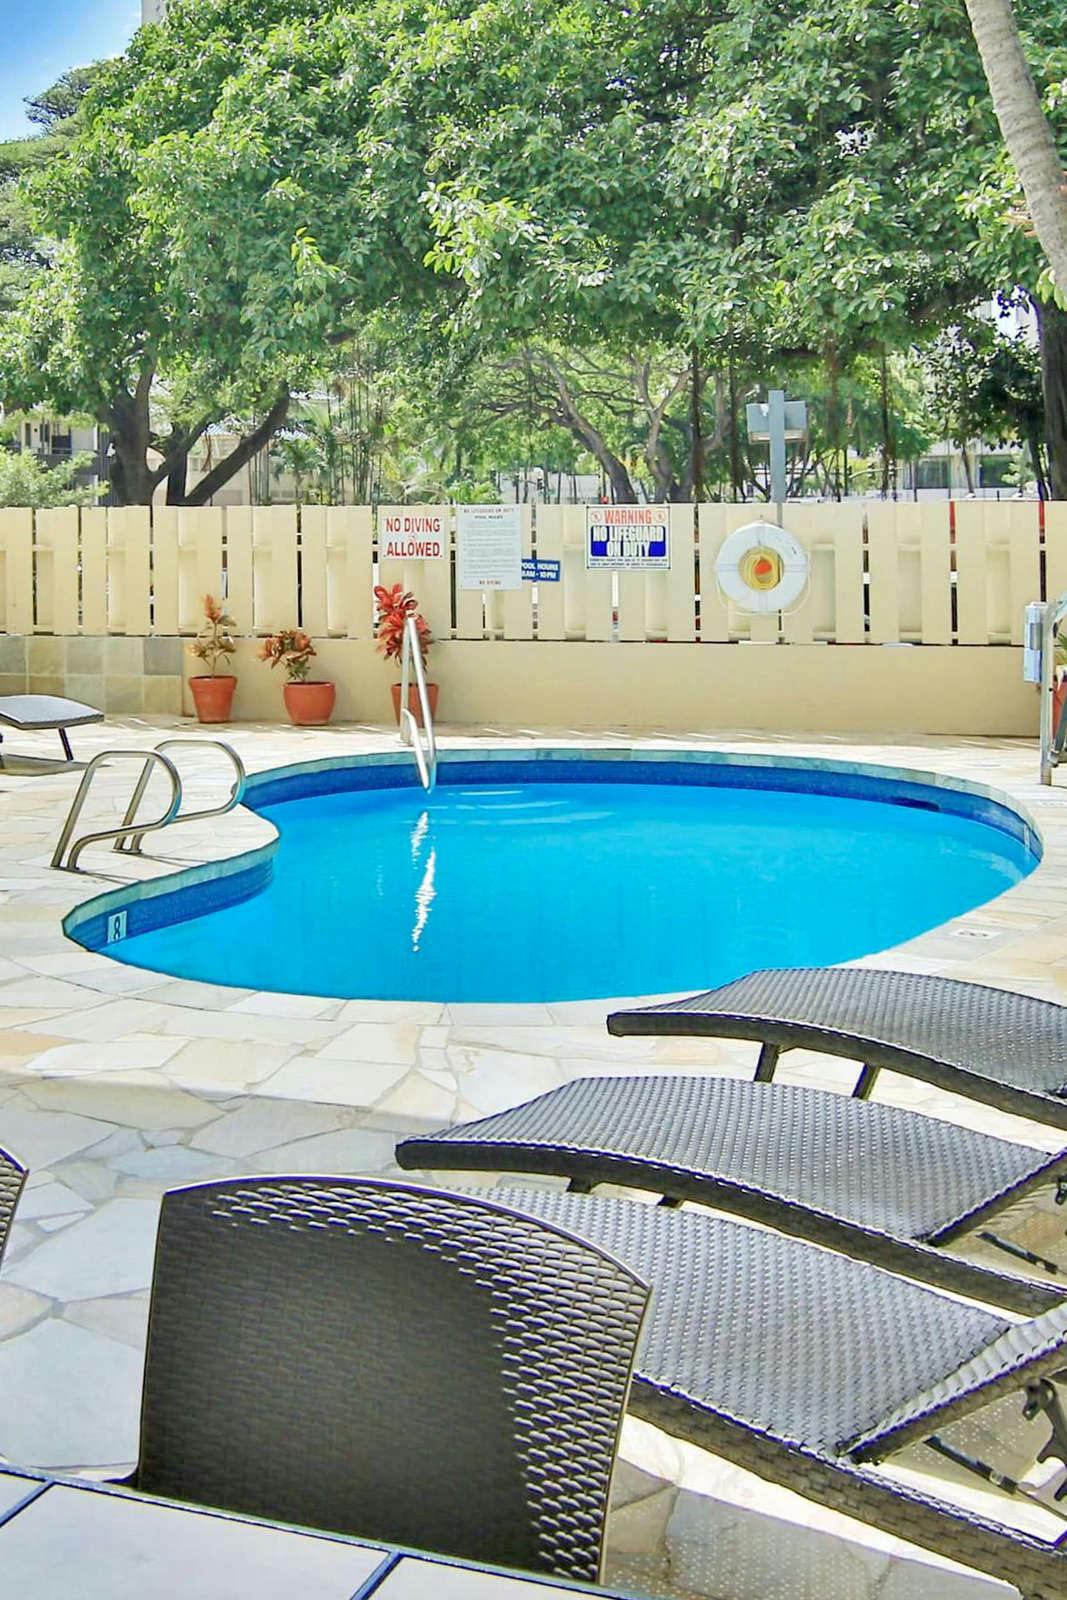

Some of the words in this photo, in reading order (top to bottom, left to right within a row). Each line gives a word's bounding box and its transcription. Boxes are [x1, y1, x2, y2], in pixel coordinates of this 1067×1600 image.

[604, 510, 652, 524] WARNING
[386, 518, 401, 532] NO
[404, 518, 440, 532] DIVING
[593, 526, 607, 541] NO
[609, 526, 664, 541] LIFEGUARD
[387, 542, 440, 556] ALLOWED
[607, 541, 621, 557] ON
[623, 541, 650, 557] DUTY
